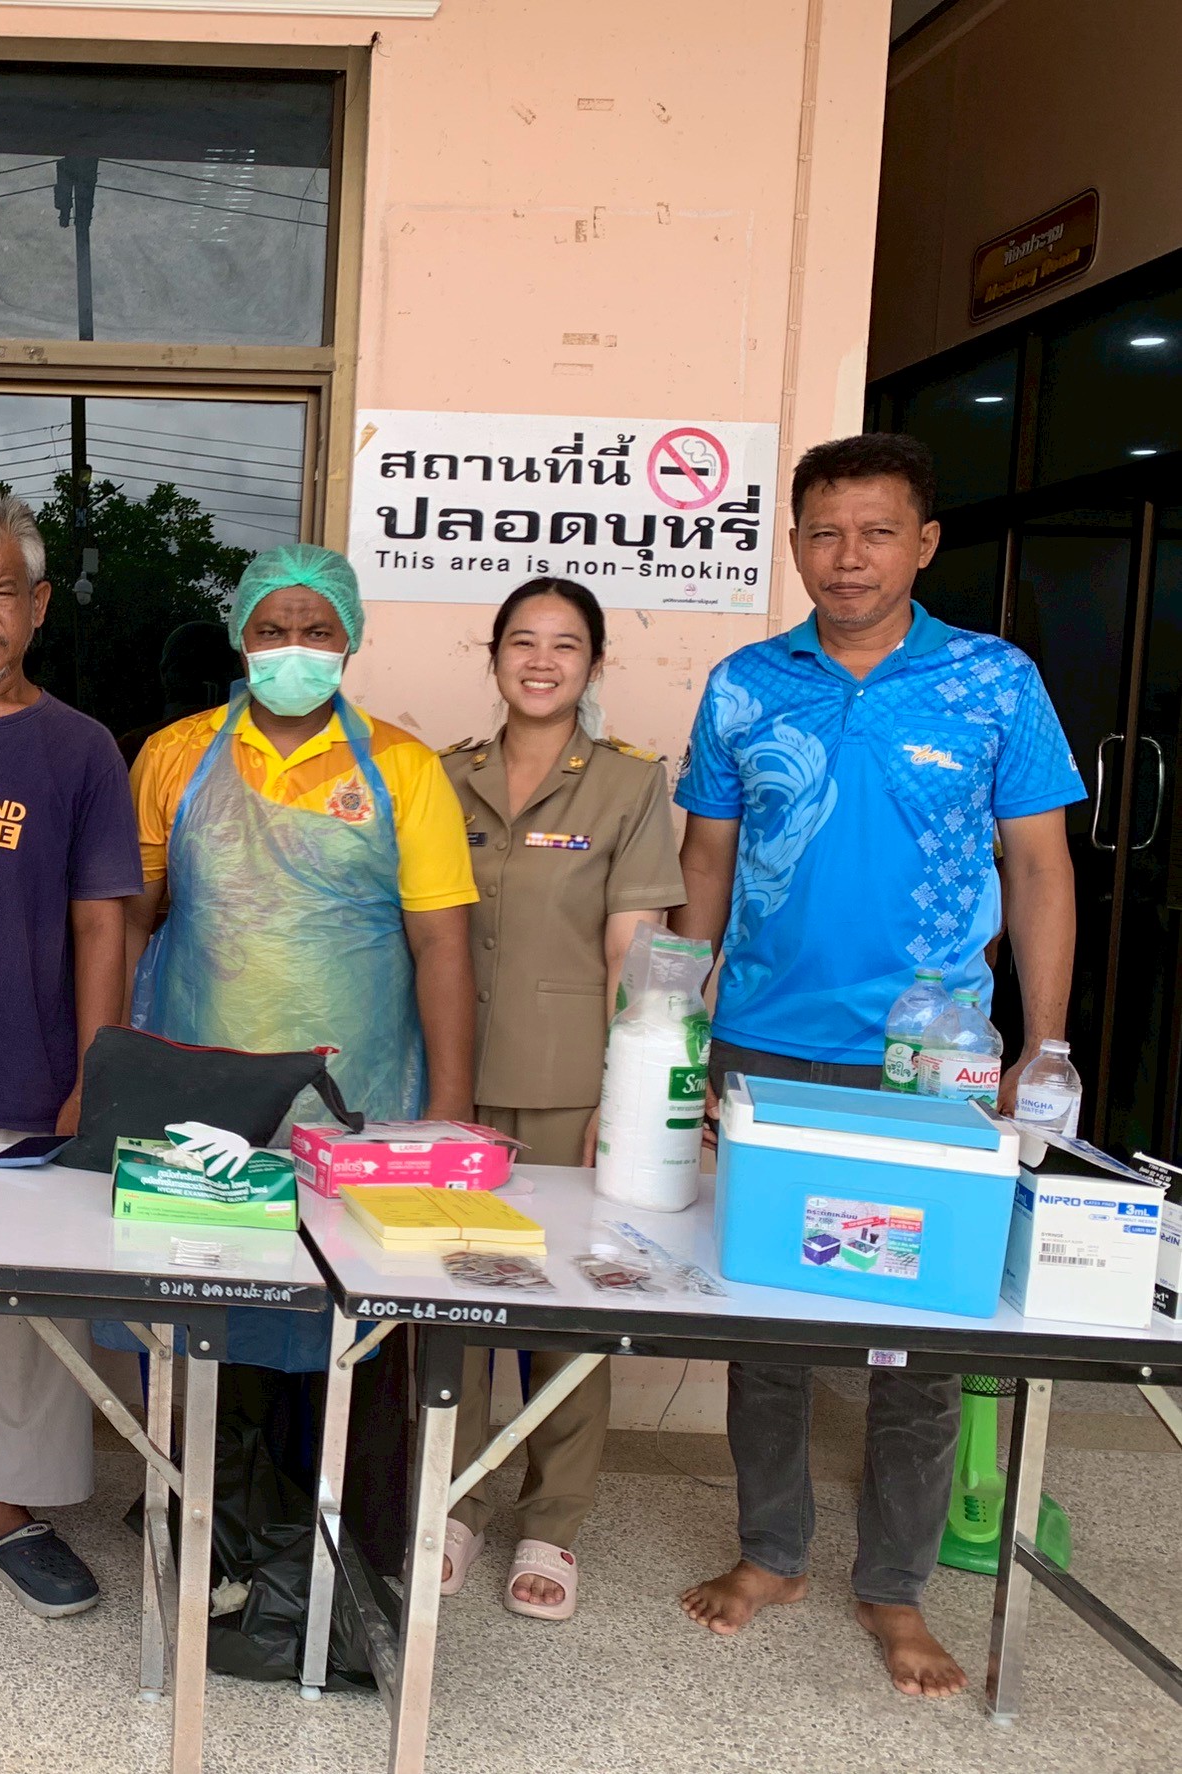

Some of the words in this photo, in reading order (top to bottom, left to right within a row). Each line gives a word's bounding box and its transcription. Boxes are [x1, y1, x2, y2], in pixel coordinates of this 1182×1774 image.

[379, 432, 636, 486] สถานที่นี้
[376, 485, 761, 561] ปลอดบุหรี่
[375, 550, 435, 570] This
[450, 556, 511, 573] area
[526, 554, 550, 574] is
[565, 558, 760, 585] non-smoking
[955, 1067, 1000, 1084] Aura
[1021, 1098, 1054, 1110] SINGHA
[1021, 1105, 1045, 1115] WATER
[1039, 1194, 1081, 1207] NIPRO
[1125, 1204, 1151, 1217] 3mL
